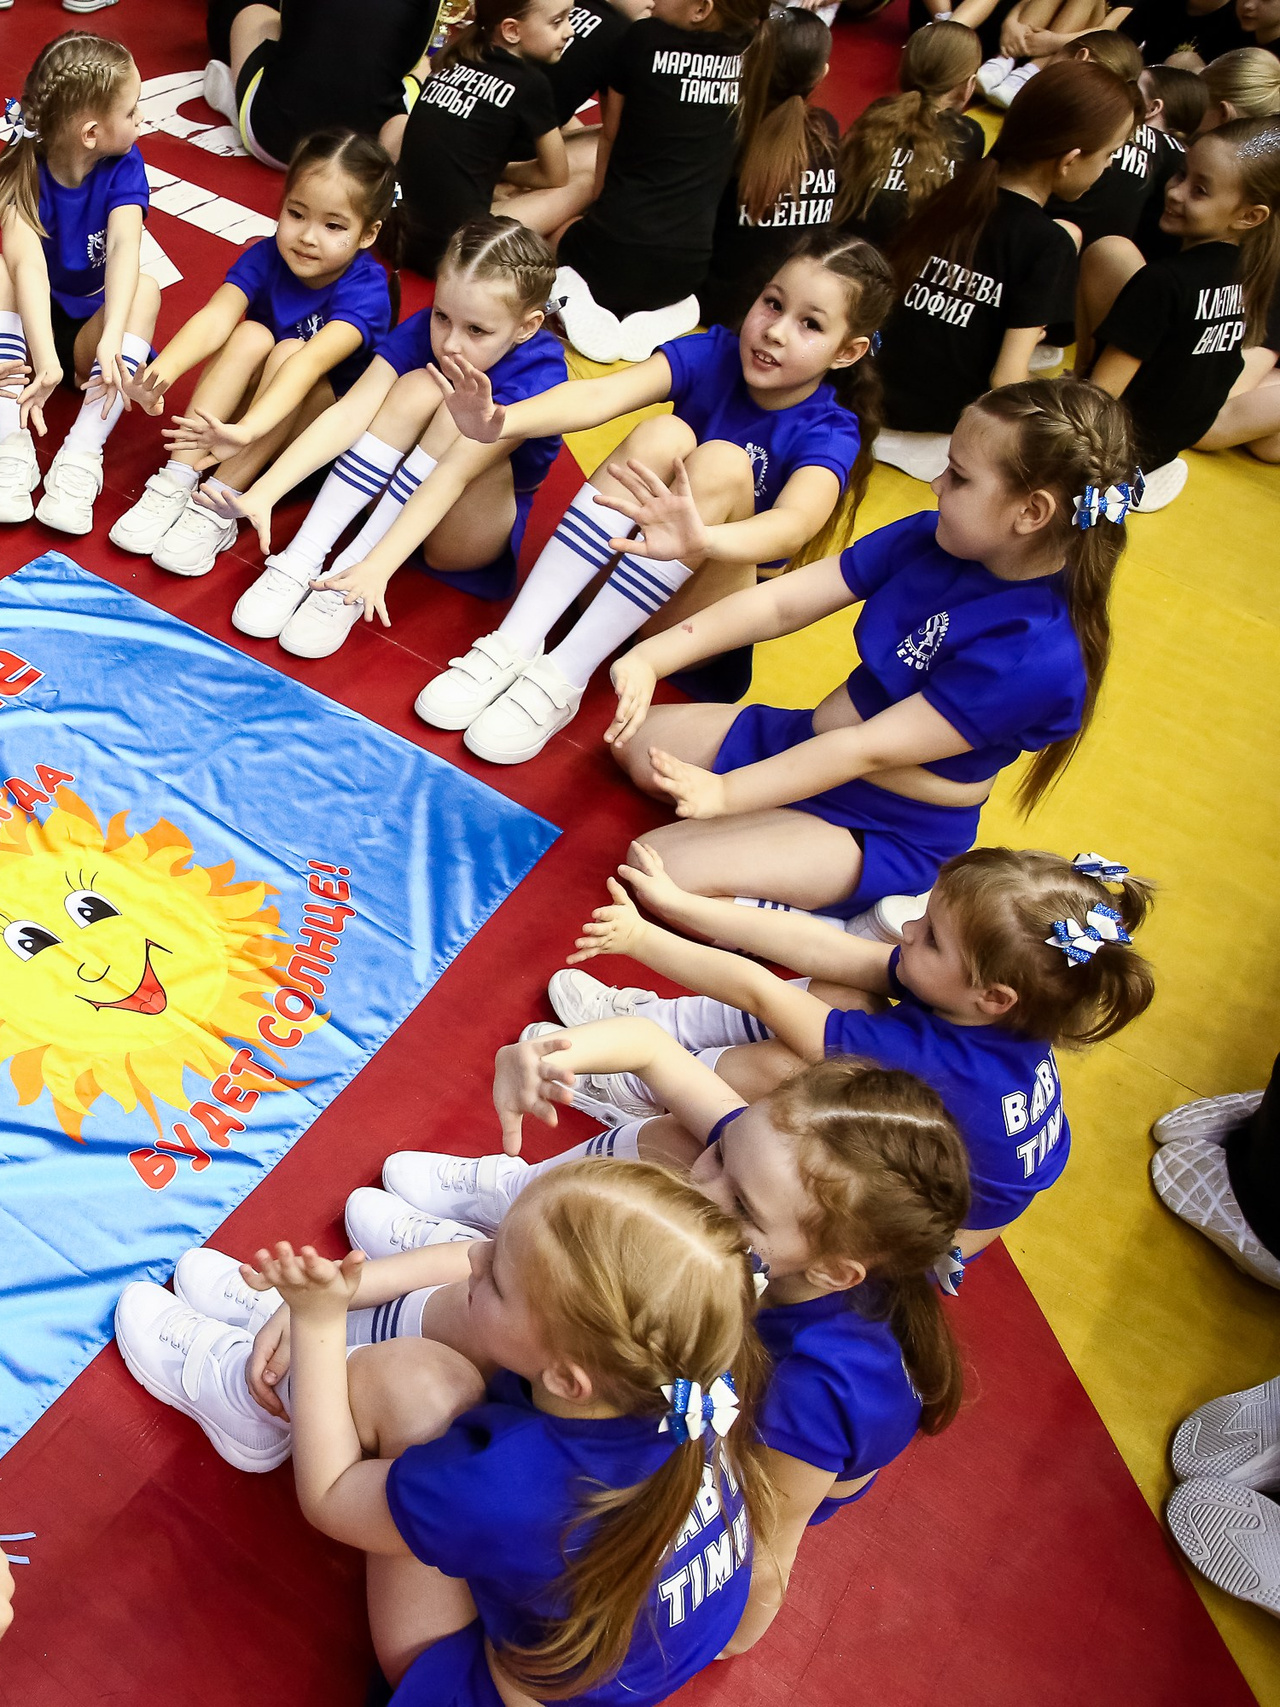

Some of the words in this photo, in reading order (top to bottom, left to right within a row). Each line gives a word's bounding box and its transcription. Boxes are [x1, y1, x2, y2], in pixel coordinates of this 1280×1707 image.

[420, 80, 478, 119] СОФЬЯ
[680, 78, 739, 104] ТАИСИЯ
[904, 283, 976, 328] СОФИЯ
[127, 1048, 276, 1192] БУДЕТ
[257, 858, 356, 1049] СОЛНЦЕ!
